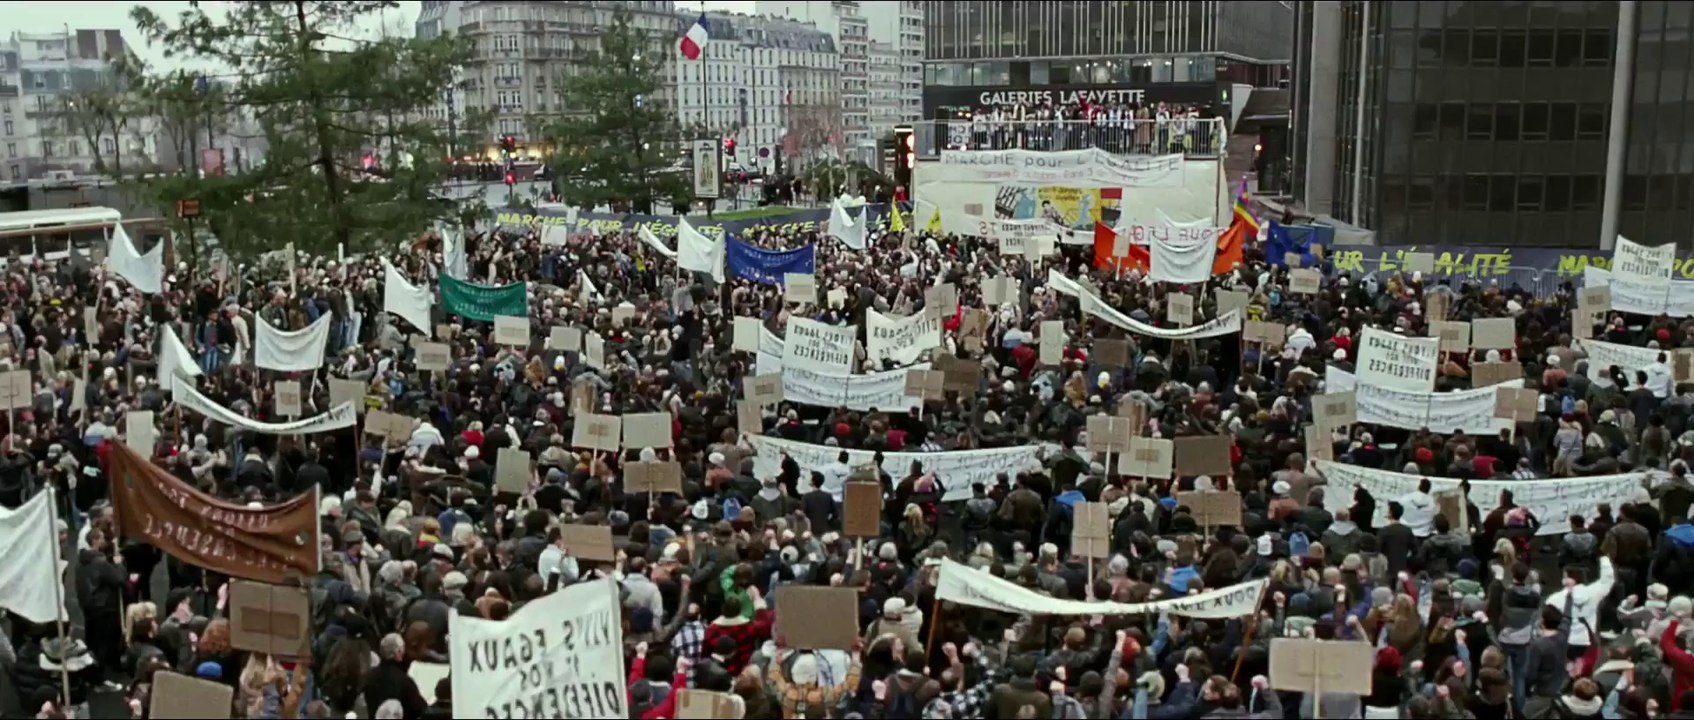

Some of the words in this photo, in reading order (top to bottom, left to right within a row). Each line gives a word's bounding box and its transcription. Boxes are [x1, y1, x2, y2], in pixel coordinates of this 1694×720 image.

[980, 90, 1052, 105] GALERIES
[1060, 90, 1145, 104] LAFAYETTE
[497, 212, 567, 225] MARCHE
[1334, 250, 1364, 273] UR
[1380, 246, 1511, 276] L'ALITÉ
